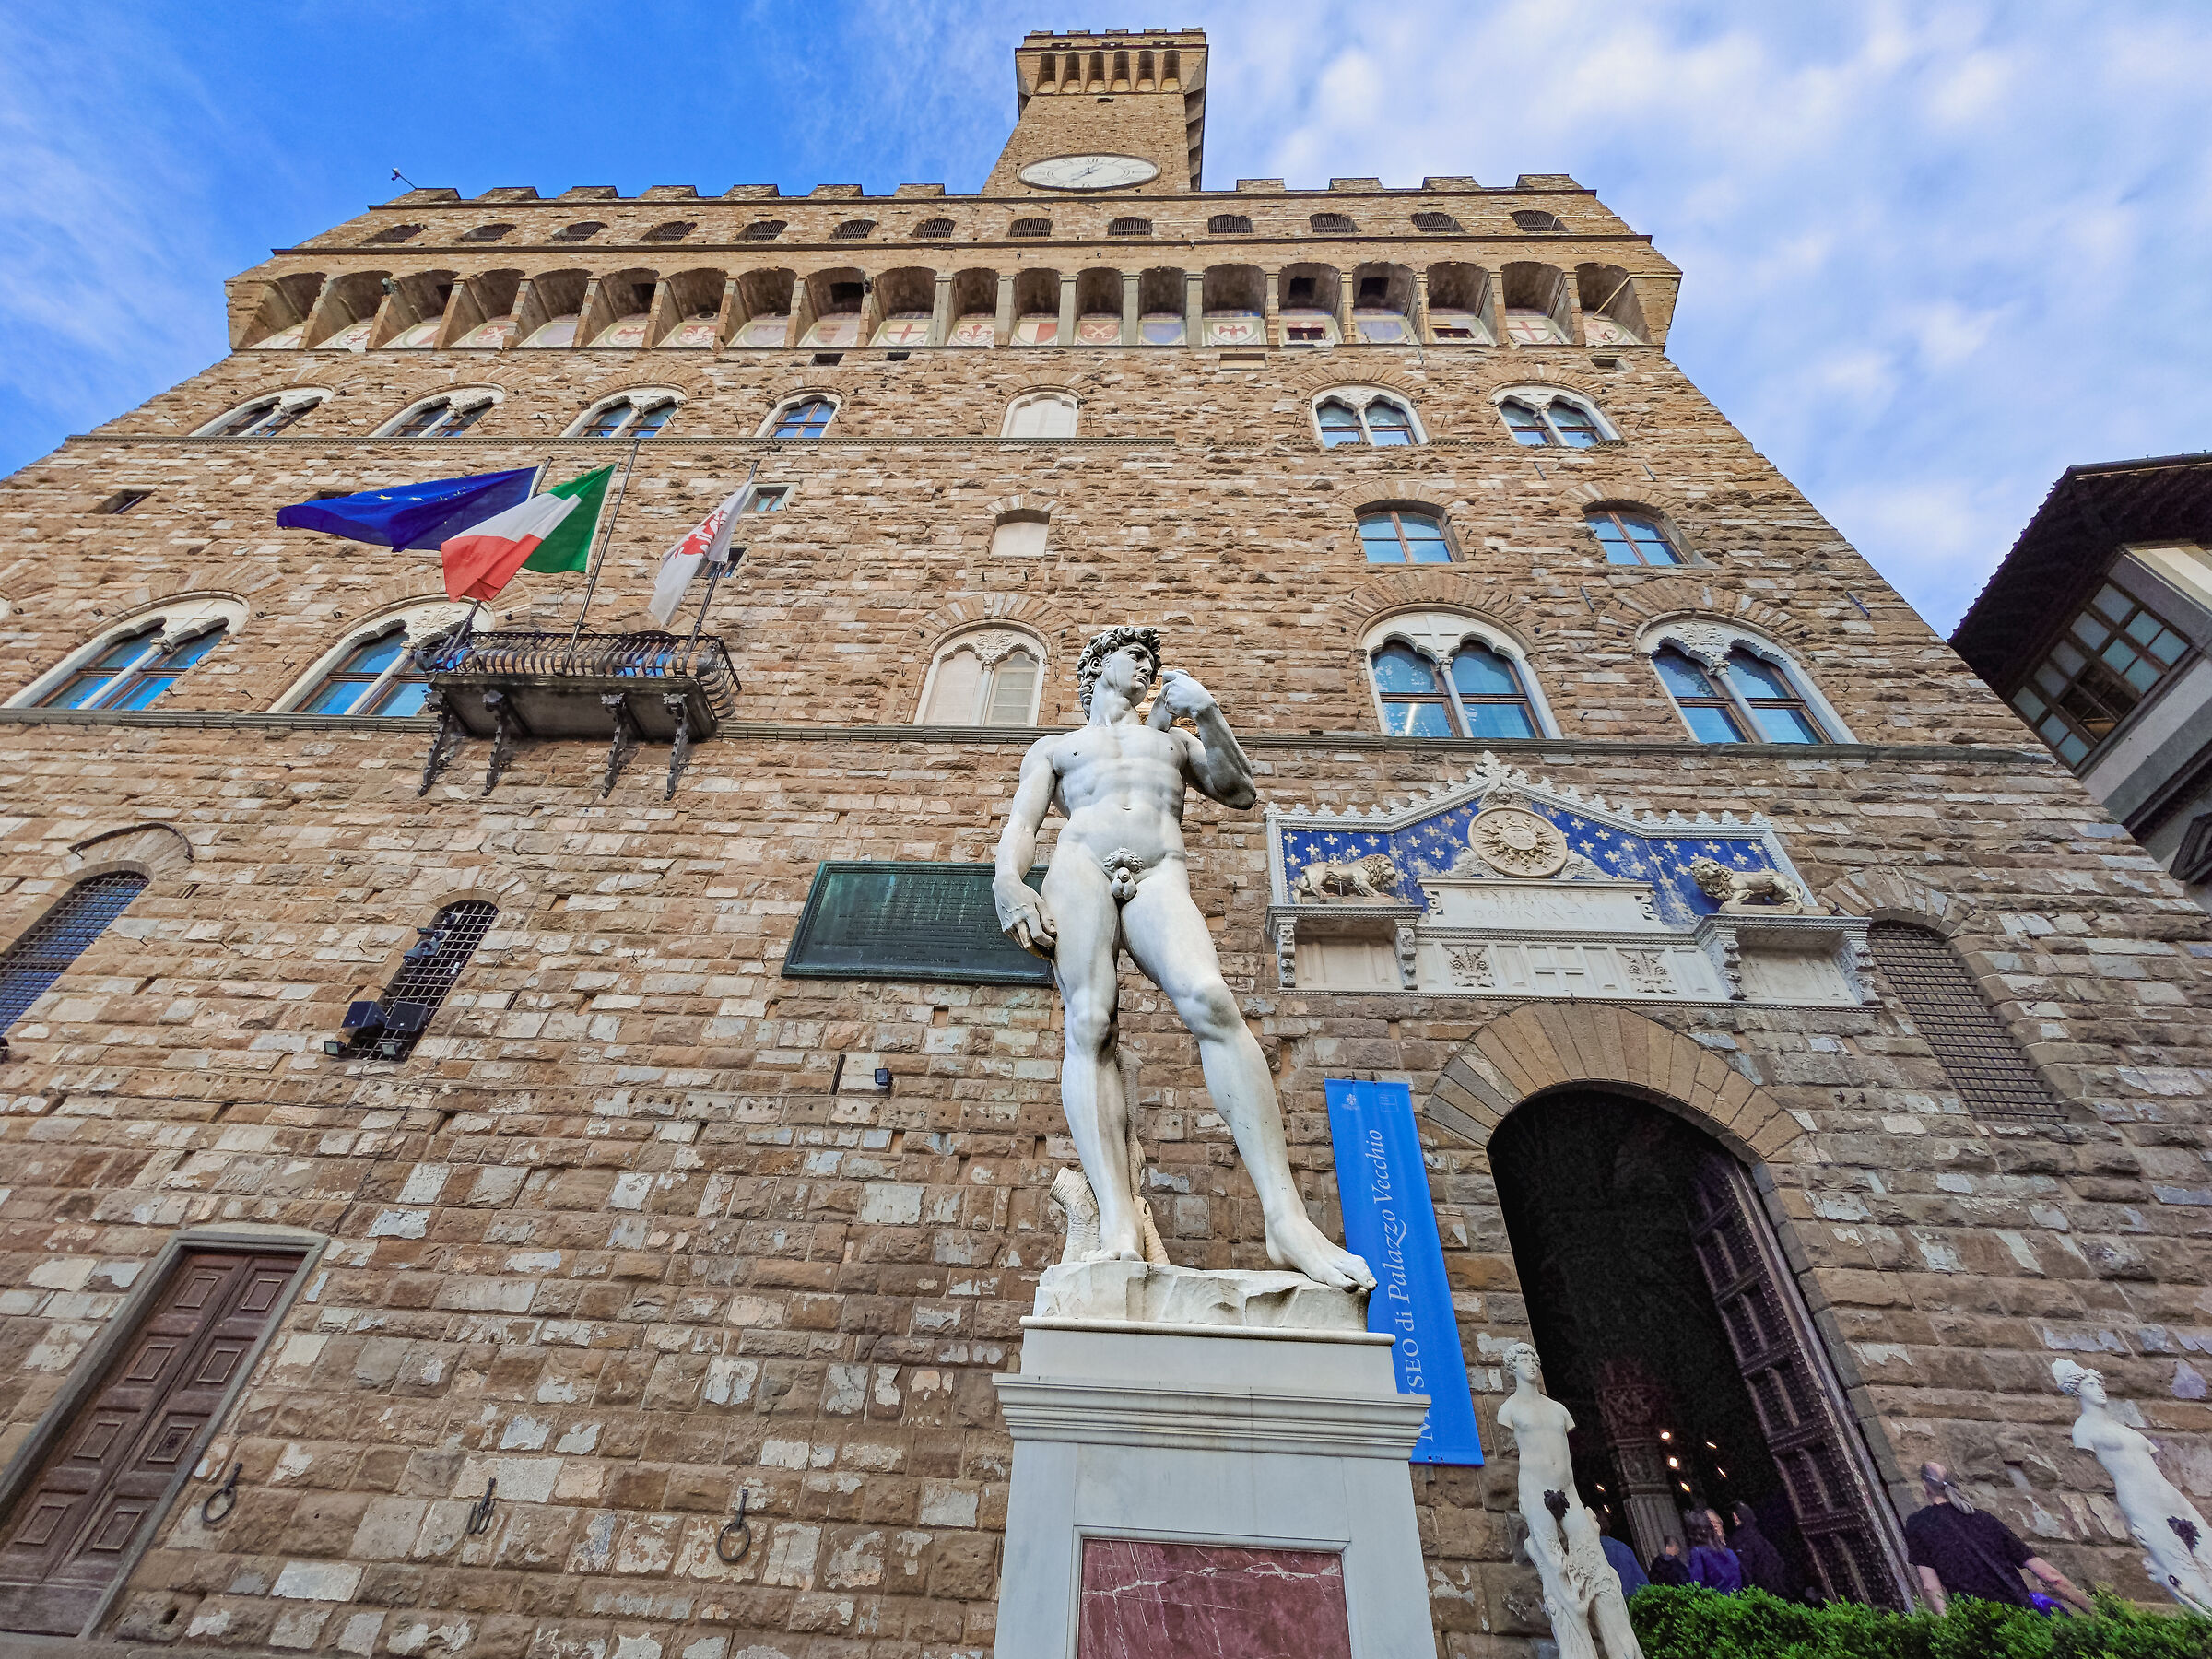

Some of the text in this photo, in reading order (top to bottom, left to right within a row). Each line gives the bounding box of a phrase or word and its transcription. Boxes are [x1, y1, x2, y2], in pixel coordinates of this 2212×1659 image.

[1365, 1129, 1393, 1204] Vecchio
[1382, 1209, 1411, 1304] Palazzo
[1394, 1311, 1415, 1332] di
